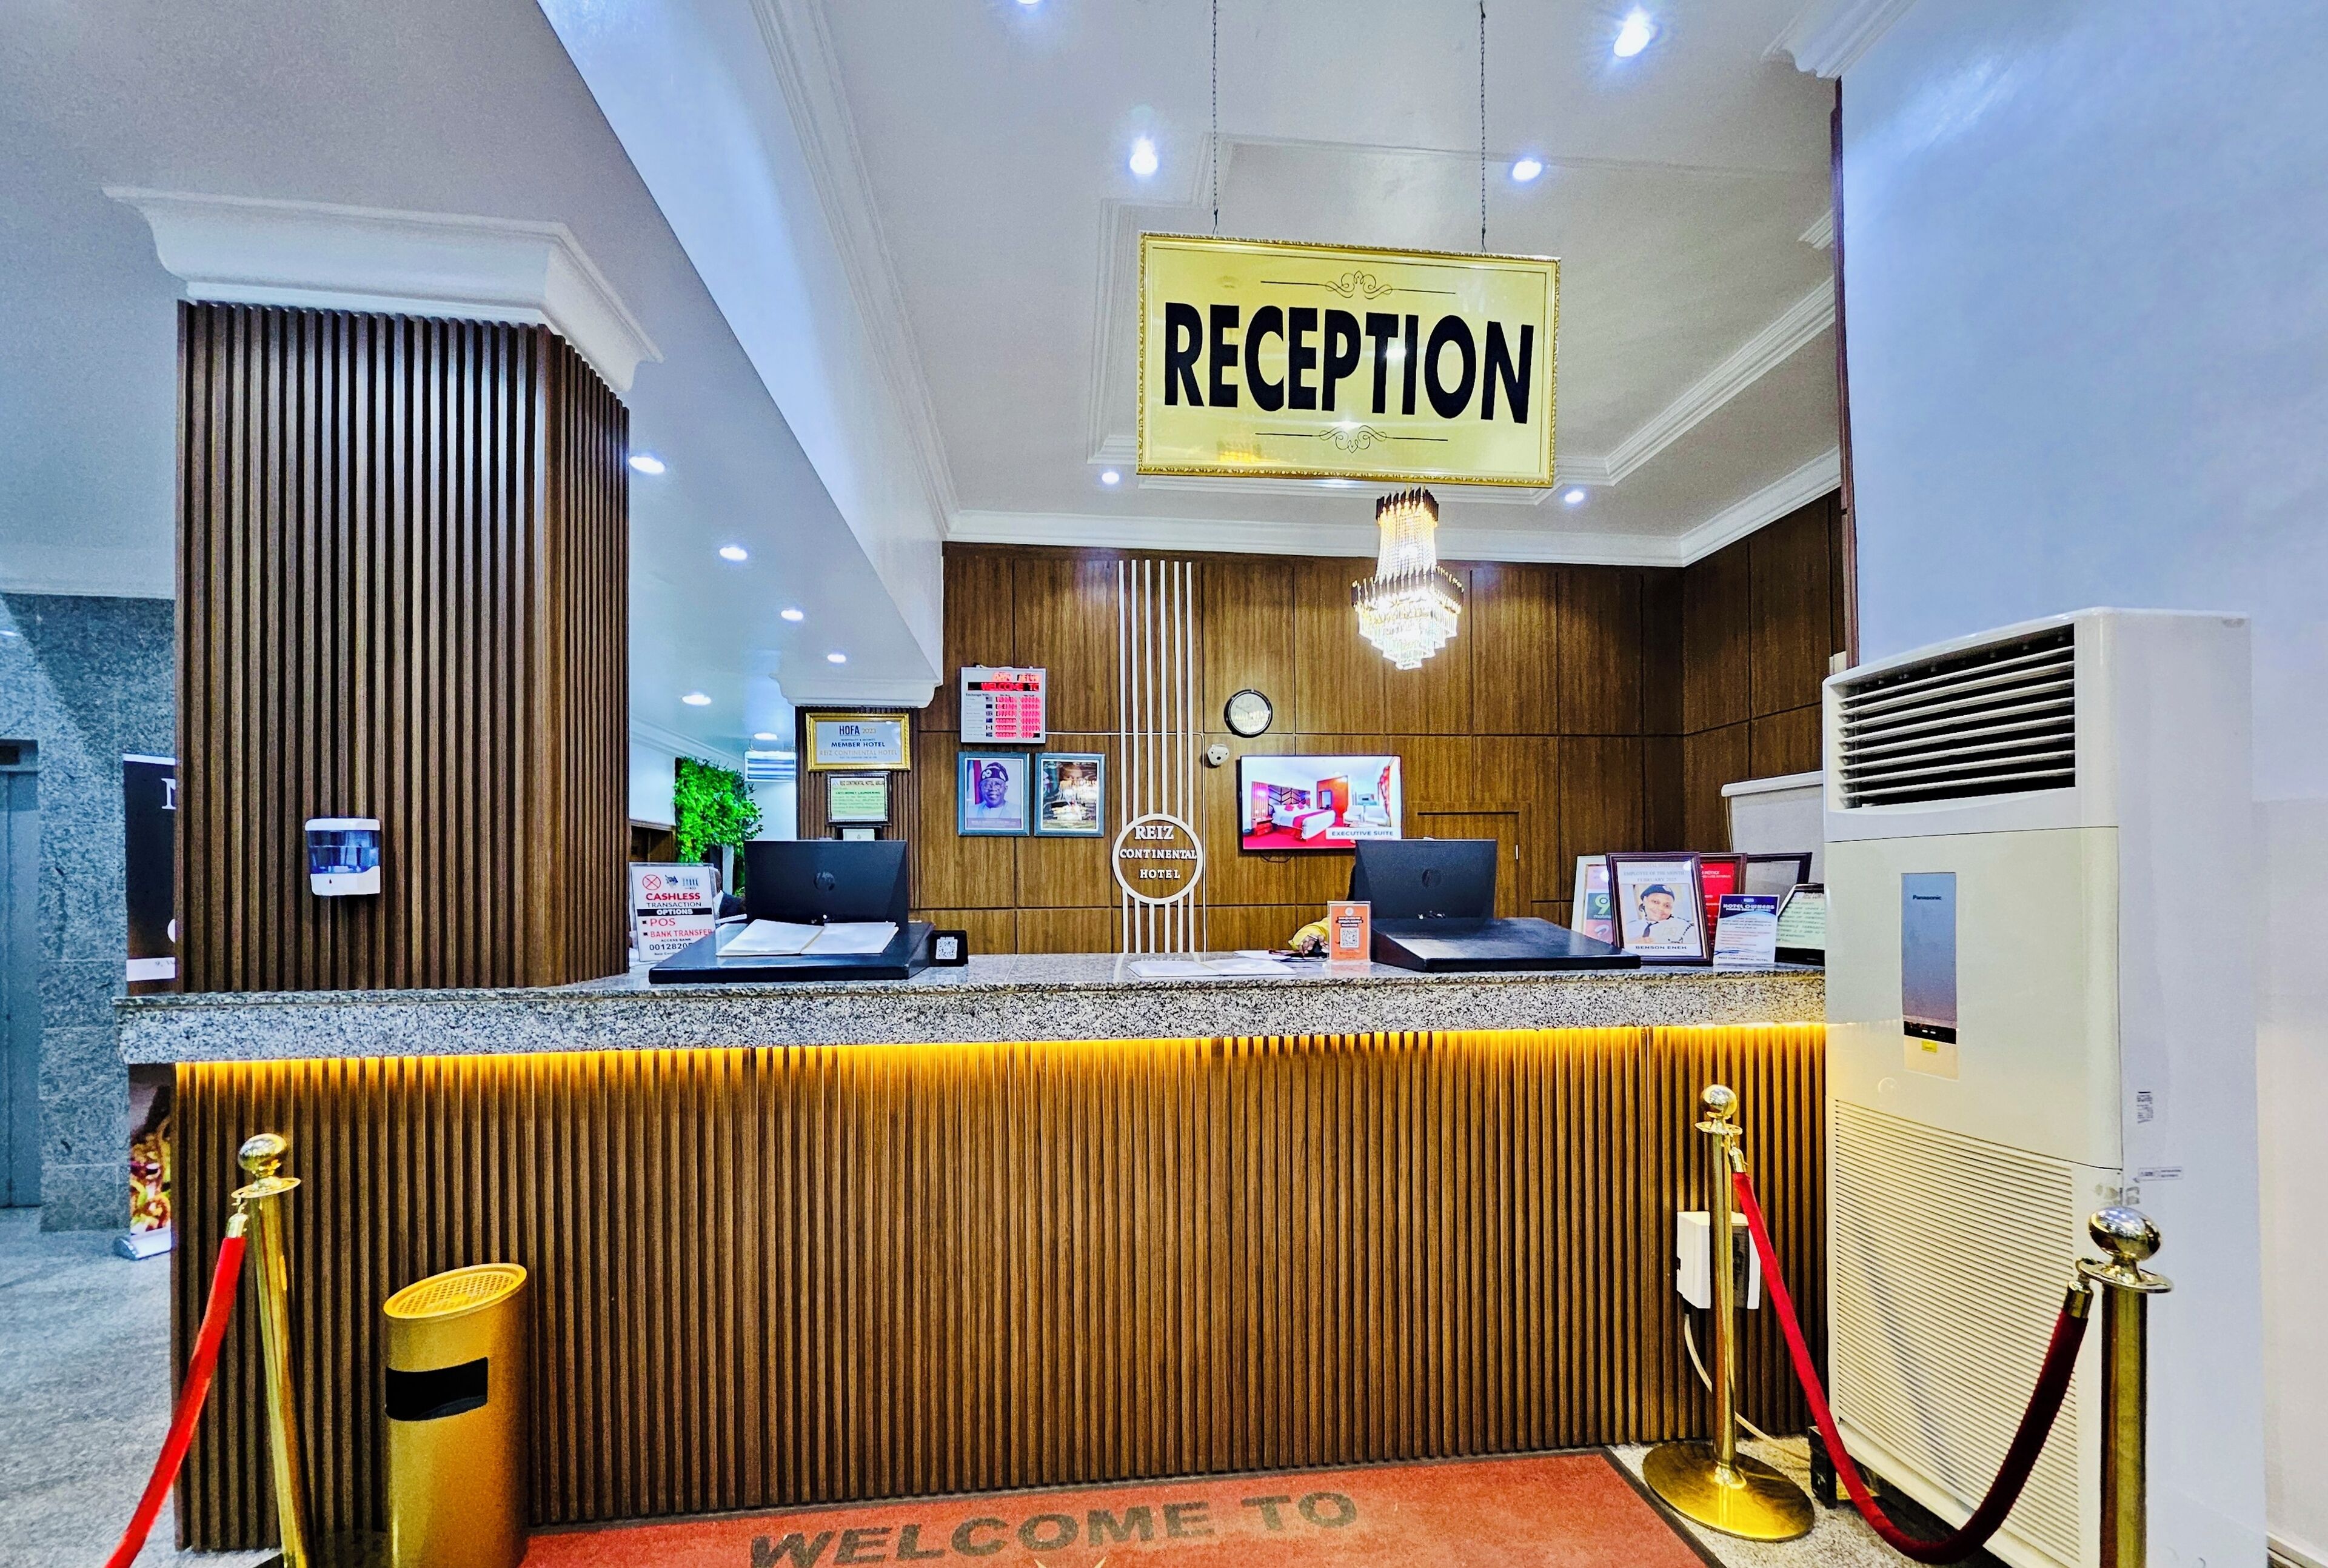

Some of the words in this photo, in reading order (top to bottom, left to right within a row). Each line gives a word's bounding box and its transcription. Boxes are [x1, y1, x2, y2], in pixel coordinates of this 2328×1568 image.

[1164, 301, 1534, 424] RECEPTION
[980, 682, 1023, 691] WELCOME
[839, 726, 860, 735] HOFA
[1134, 826, 1174, 840] REIZ
[1120, 849, 1197, 859] CONTINENTAL
[1140, 869, 1180, 879] HOTEL
[751, 1501, 1214, 1568] WELCOME
[1240, 1492, 1358, 1531] TO
